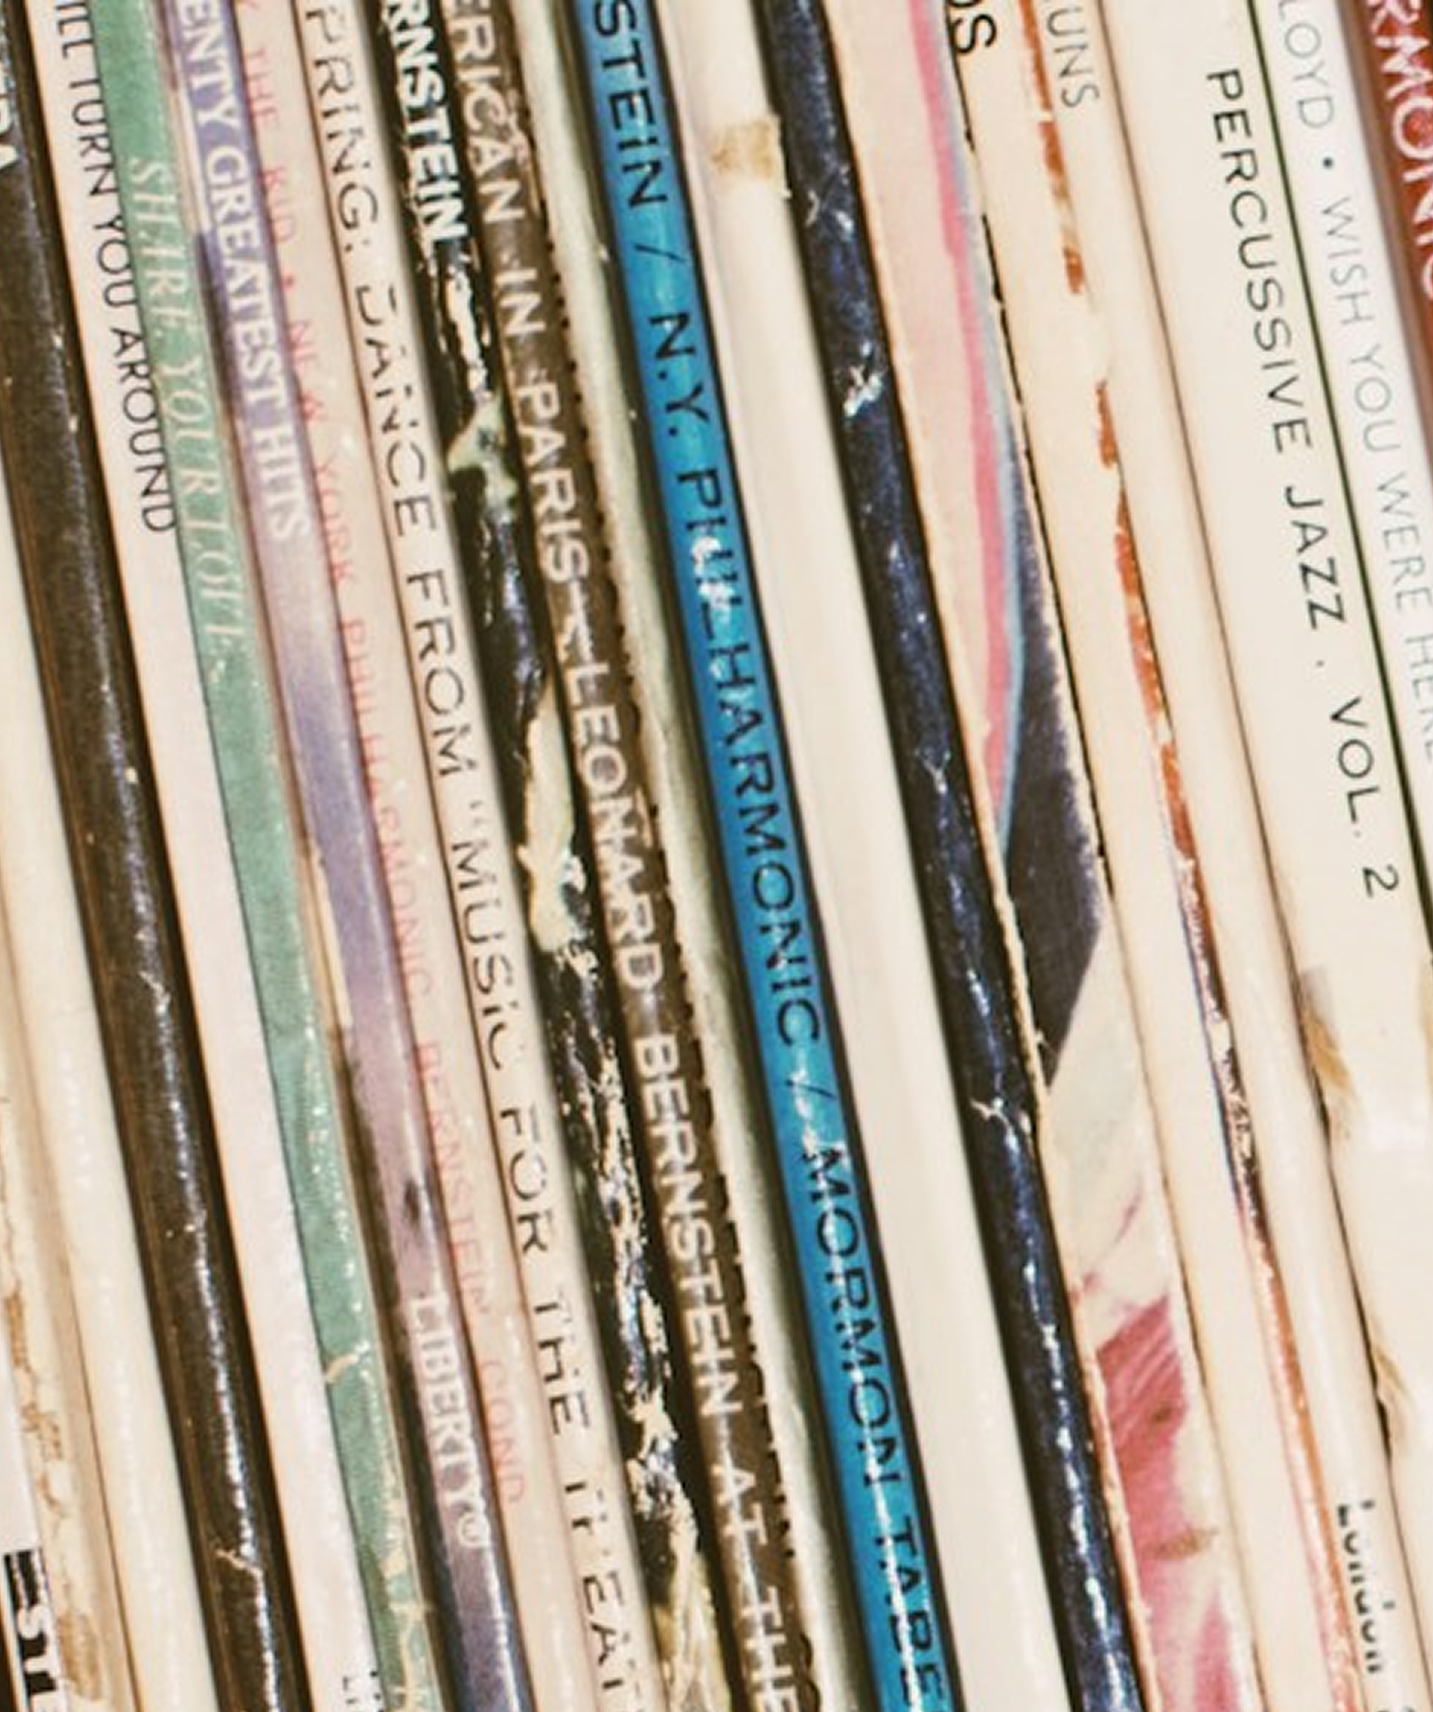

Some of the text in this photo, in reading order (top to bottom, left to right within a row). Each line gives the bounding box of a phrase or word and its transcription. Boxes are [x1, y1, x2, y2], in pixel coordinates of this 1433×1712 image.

[68, 79, 124, 197] TURN
[591, 0, 668, 208] STEIN
[90, 211, 137, 309] YOU
[205, 143, 286, 408] GREATEST
[250, 427, 308, 543] HITS
[647, 311, 709, 438] N.Y.
[1319, 197, 1375, 326] WISH
[1347, 344, 1401, 454] YOU
[109, 326, 177, 533] AROUND
[159, 360, 222, 497] YOUR
[1206, 69, 1400, 898] PERCUSSIVE JAZZ VOL. 2
[355, 283, 437, 538] DANCE
[405, 570, 476, 778] FROM
[498, 1101, 551, 1255] FOR
[531, 1295, 591, 1435] THE
[675, 468, 819, 1046] PHILHARMONIC
[500, 268, 545, 339] IN
[562, 663, 666, 992] LEONARD
[631, 1032, 744, 1419] BERNSTEIN
[712, 1464, 768, 1549] AT
[801, 1149, 906, 1489] MORMON
